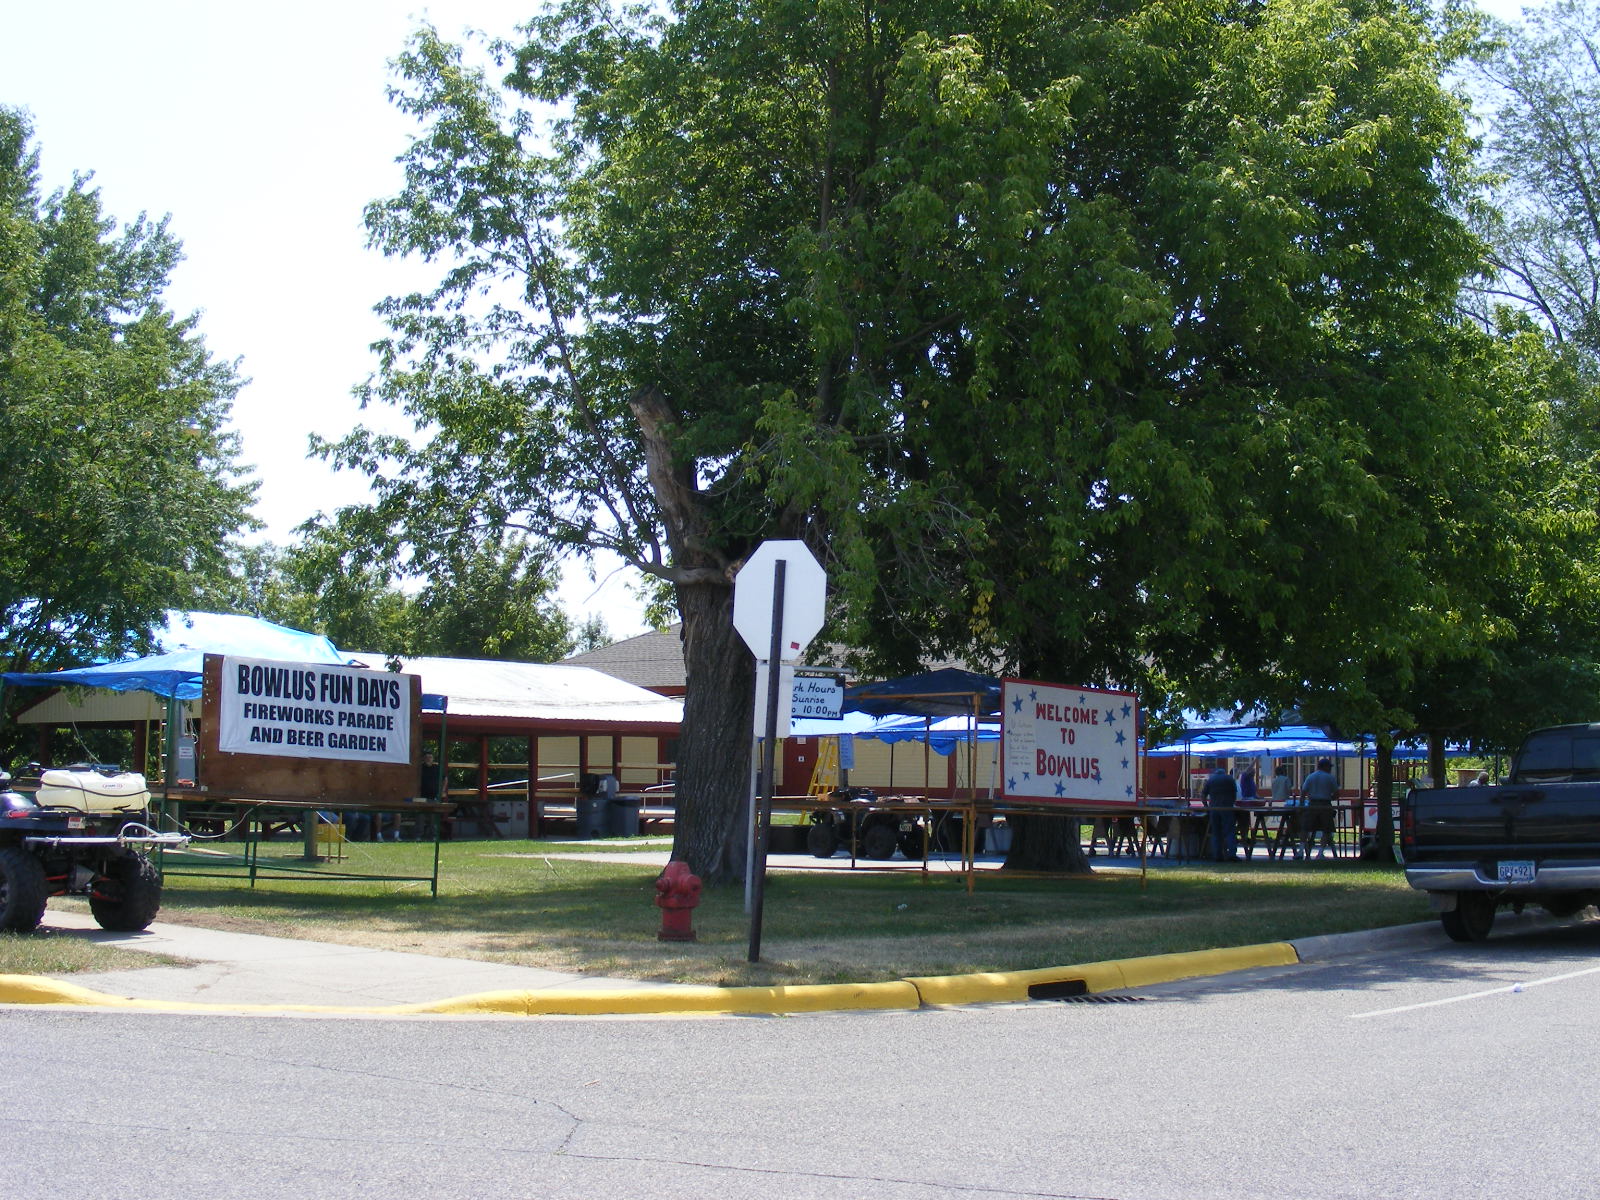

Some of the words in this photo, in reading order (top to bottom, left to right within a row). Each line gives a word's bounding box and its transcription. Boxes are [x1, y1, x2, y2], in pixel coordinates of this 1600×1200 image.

[238, 664, 315, 701] BOWLUS
[320, 672, 353, 704] FUN
[357, 677, 400, 709] DAYS
[792, 694, 825, 703] Sunrise
[808, 682, 836, 693] Hours
[244, 703, 334, 726] FIREWORKS
[338, 711, 394, 731] PARADE
[1036, 702, 1098, 725] WELCOME
[250, 726, 283, 744] AND
[287, 729, 324, 748] BEER
[328, 732, 386, 752] GARDEN
[1061, 728, 1075, 744] TO
[1037, 748, 1100, 780] BOWLUS
